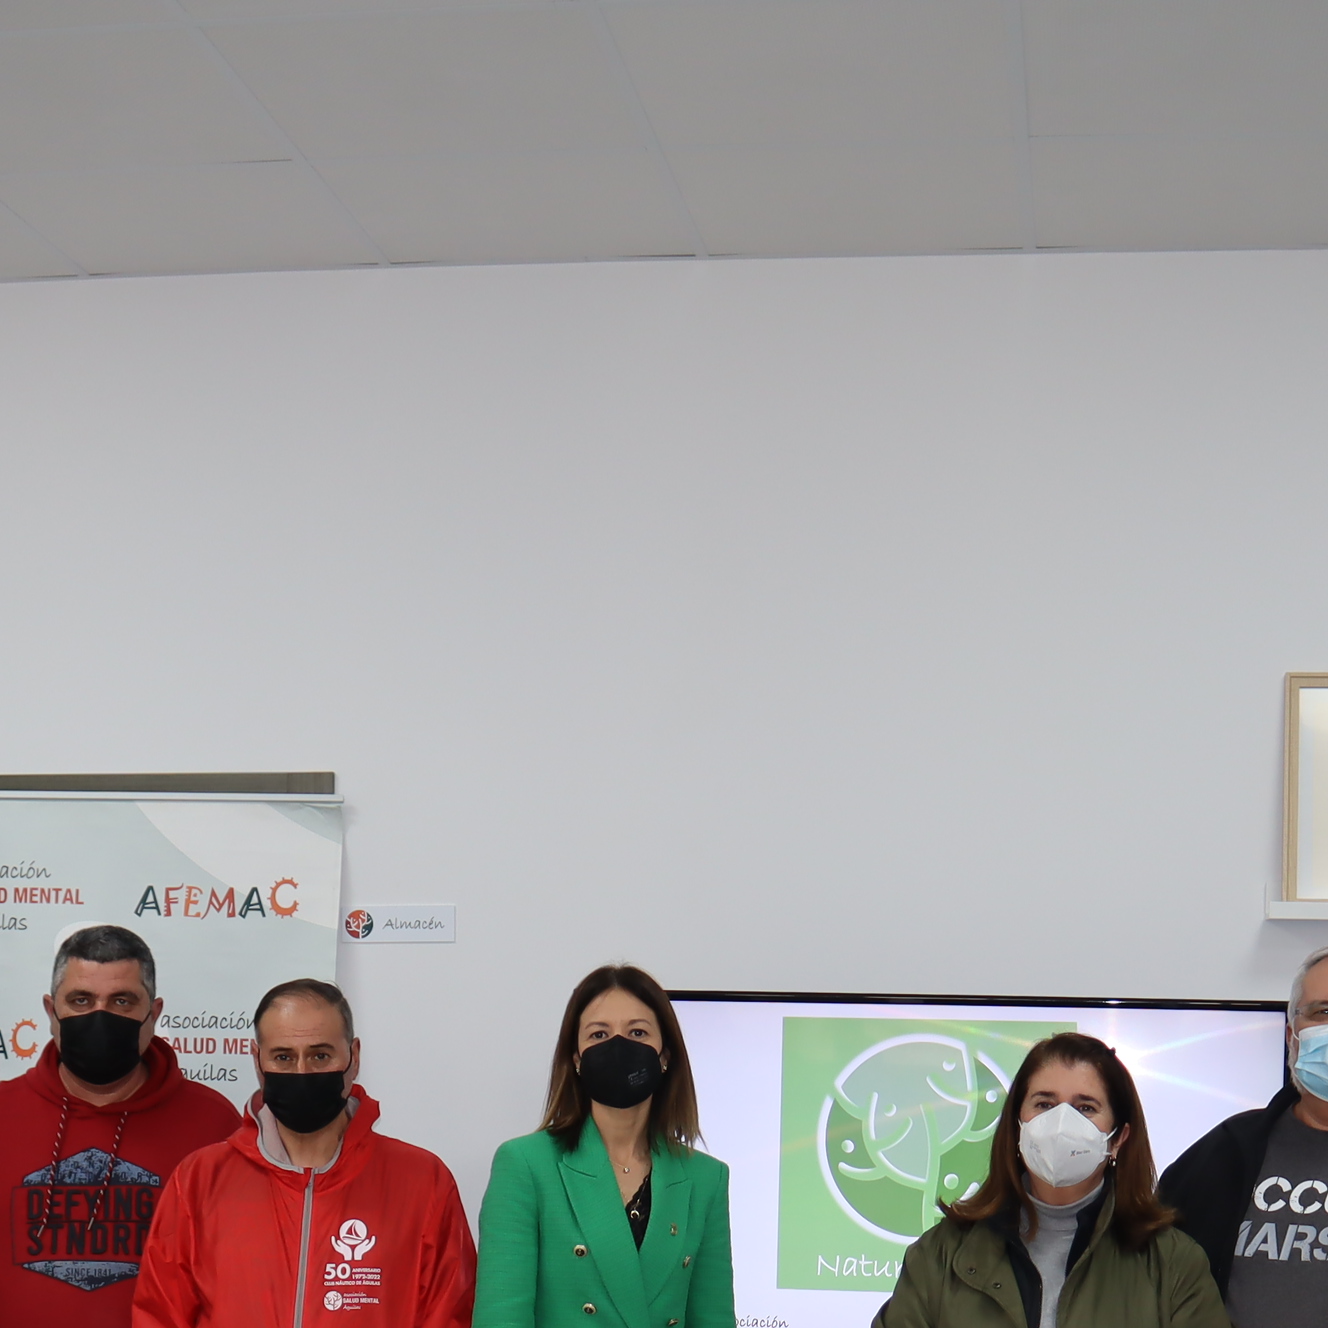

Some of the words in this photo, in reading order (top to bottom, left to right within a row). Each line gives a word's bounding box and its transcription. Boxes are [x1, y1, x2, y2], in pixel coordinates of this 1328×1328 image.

[13, 887, 84, 905] MENTAL
[134, 877, 299, 920] AFEMAC
[382, 916, 445, 930] Almacén
[27, 1188, 154, 1220] DEFYING
[65, 1268, 91, 1277] SINCE
[324, 1263, 351, 1280] 50
